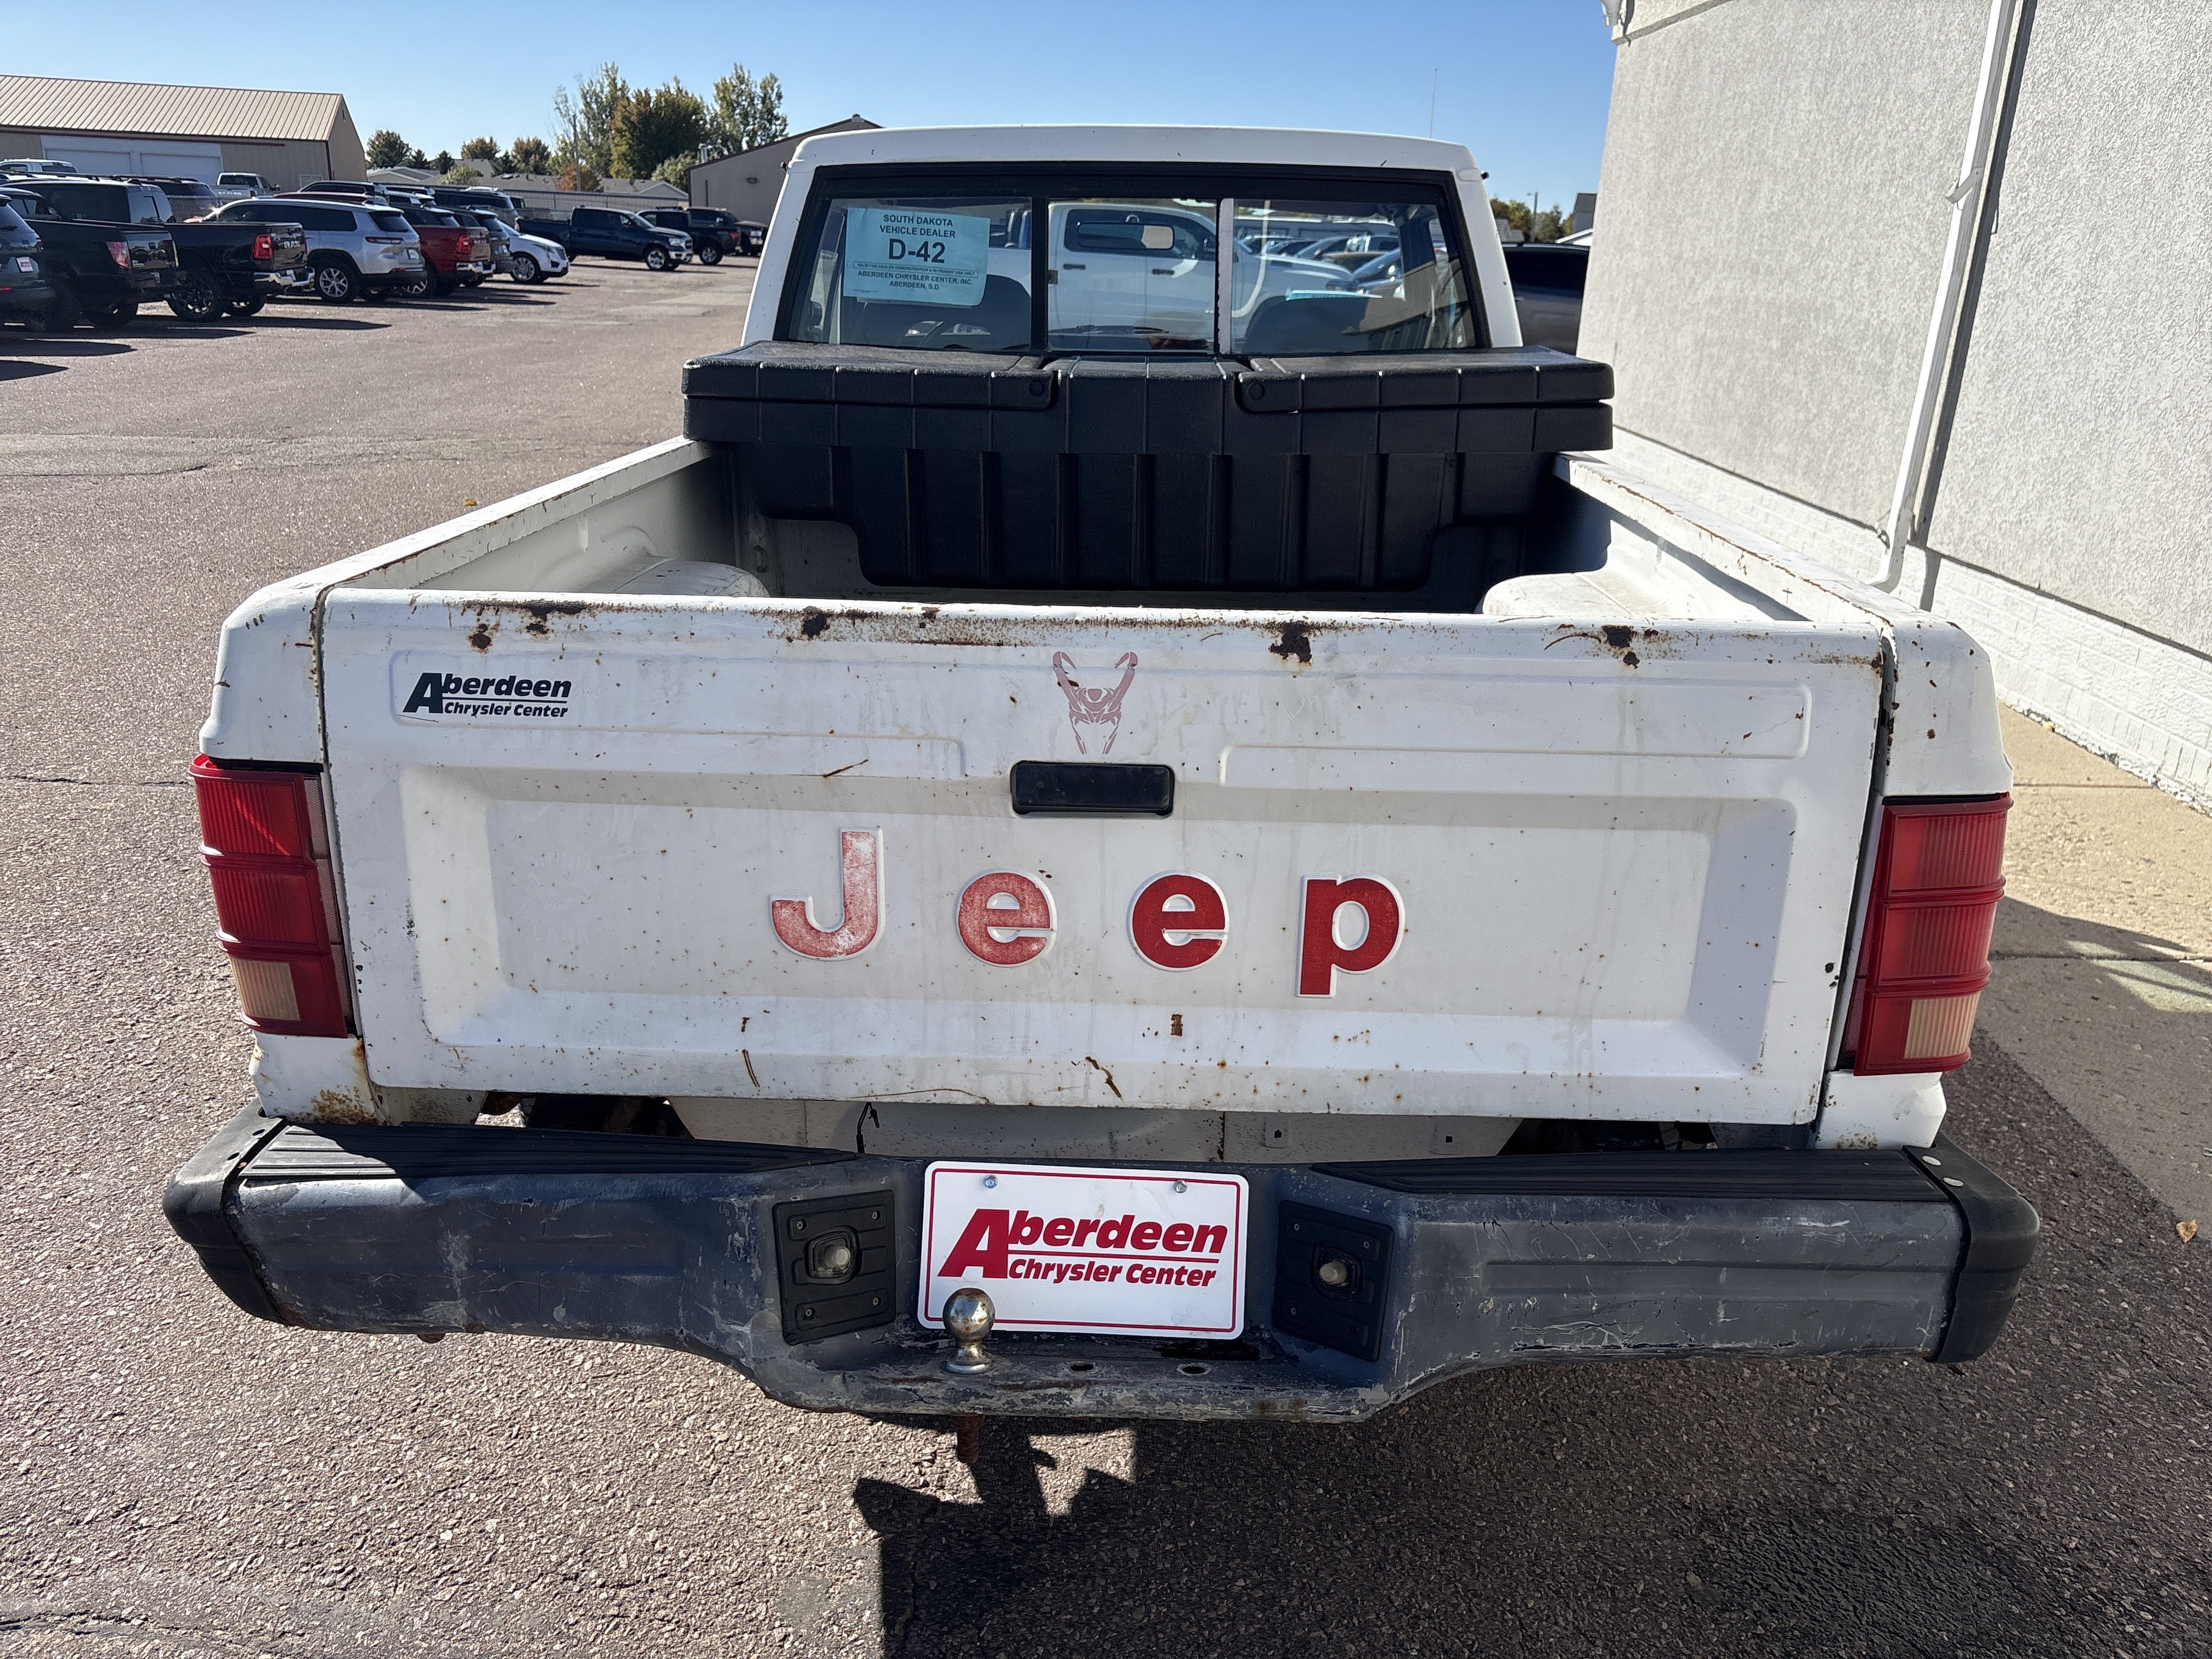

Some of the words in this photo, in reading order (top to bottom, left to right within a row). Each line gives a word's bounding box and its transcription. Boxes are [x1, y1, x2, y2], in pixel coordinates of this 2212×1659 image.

[884, 215, 914, 223] SOUTH
[917, 217, 953, 227] DAKOTA
[880, 225, 917, 235] VEHICLE
[920, 228, 956, 238] DEALER
[889, 238, 945, 263] D-42
[857, 270, 893, 279] ABERDEEN
[931, 276, 959, 284] CENTER,
[889, 281, 927, 290] ABERDEEN,
[402, 673, 572, 713] Aberdeen
[444, 702, 513, 716] Chrysler
[514, 704, 568, 717] Center
[769, 826, 1406, 998] Jeep
[937, 1209, 1228, 1279] Aberdeen
[1008, 1258, 1123, 1284] Chrysler
[1126, 1263, 1216, 1287] Center
